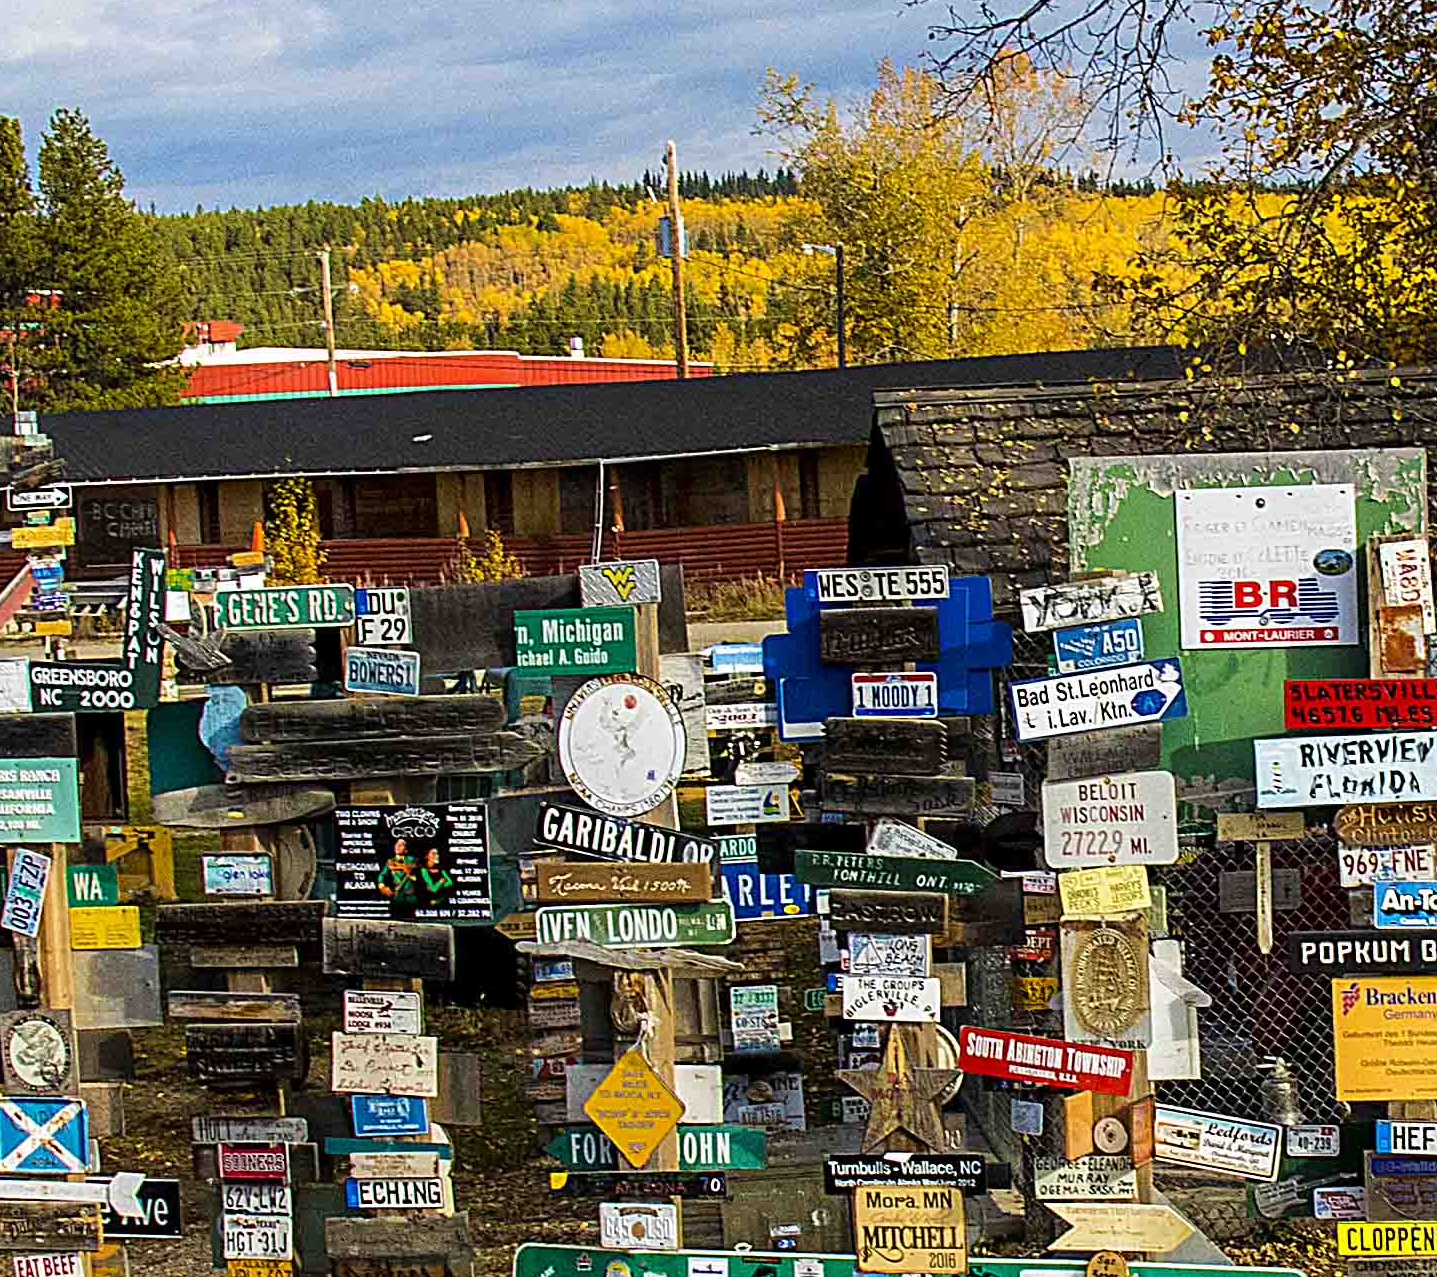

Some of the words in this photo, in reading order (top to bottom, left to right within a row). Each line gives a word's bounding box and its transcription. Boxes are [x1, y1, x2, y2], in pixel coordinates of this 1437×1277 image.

[819, 573, 858, 598] WES
[877, 571, 901, 594] TE
[906, 570, 945, 595] 555
[542, 619, 624, 647] Michigan
[1223, 628, 1316, 642] MONT-LAURIER
[32, 667, 133, 687] GREENSBORO
[40, 689, 63, 708] NC
[80, 689, 135, 709] 2000
[1078, 783, 1137, 801] BELOIT
[1060, 802, 1145, 823] WISCONSIN
[1302, 940, 1411, 964] POPKUM
[1383, 1010, 1437, 1021] Germany
[966, 1036, 1003, 1062] SOUTH
[1006, 1045, 1063, 1071] ABINGTON
[1067, 1049, 1126, 1077] TOWNSHIP
[1206, 1122, 1273, 1147] Ledfords
[360, 1181, 441, 1206] ECHING
[862, 1225, 963, 1250] MITCHELL
